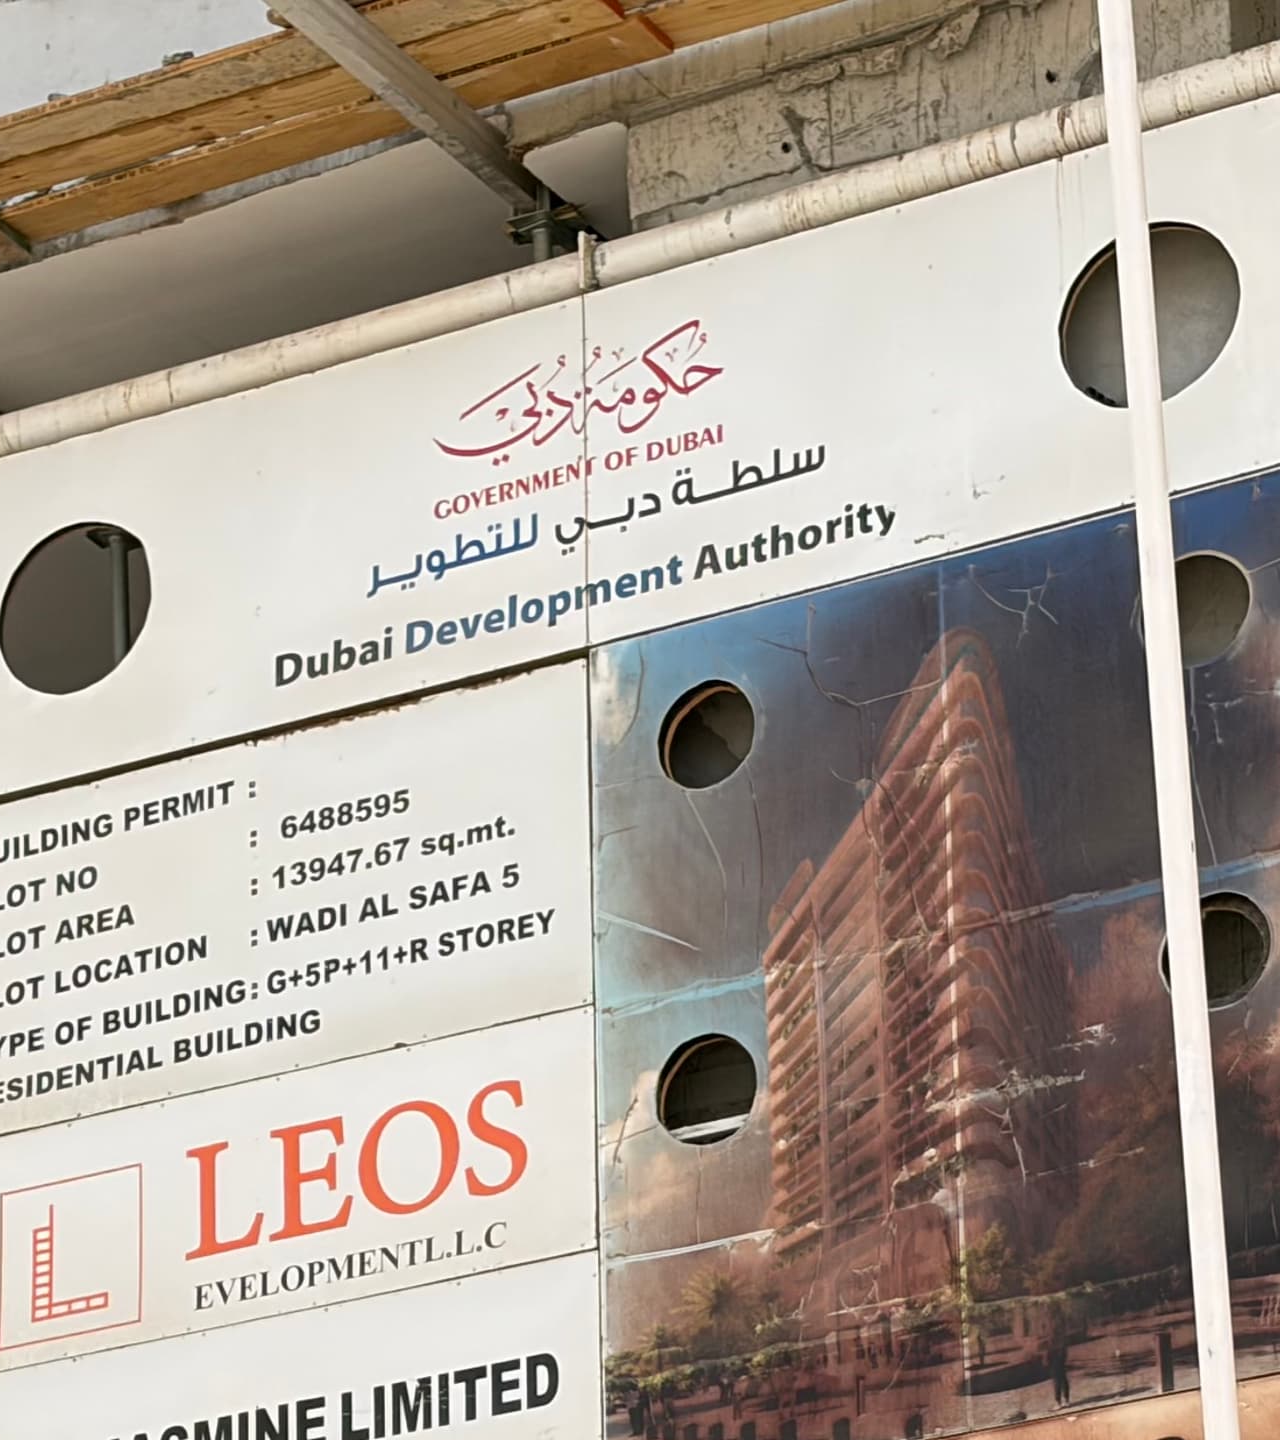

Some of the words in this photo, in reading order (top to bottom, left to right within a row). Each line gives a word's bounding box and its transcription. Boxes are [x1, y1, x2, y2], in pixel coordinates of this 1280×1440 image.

[434, 459, 596, 519] GOVERNMENT
[604, 445, 639, 472] OF
[646, 424, 724, 463] DUBAI
[274, 627, 393, 687] Dubai
[405, 553, 683, 655] Development
[694, 502, 898, 580] Authority
[56, 865, 99, 896] NO
[280, 788, 410, 840] 6488595
[123, 780, 236, 832] PERMIT
[54, 934, 209, 996] LOCATION
[266, 902, 349, 944] WADI
[359, 890, 399, 922] AL
[409, 870, 492, 912] SAFA
[501, 862, 521, 889] 5
[55, 902, 136, 944] AREA
[272, 836, 410, 891] 13947.67
[419, 816, 517, 858] sq.mt.
[54, 1016, 93, 1047] OF
[437, 907, 557, 957] STOREY
[173, 1008, 322, 1065] BUILDING
[185, 1079, 530, 1262] LEOS
